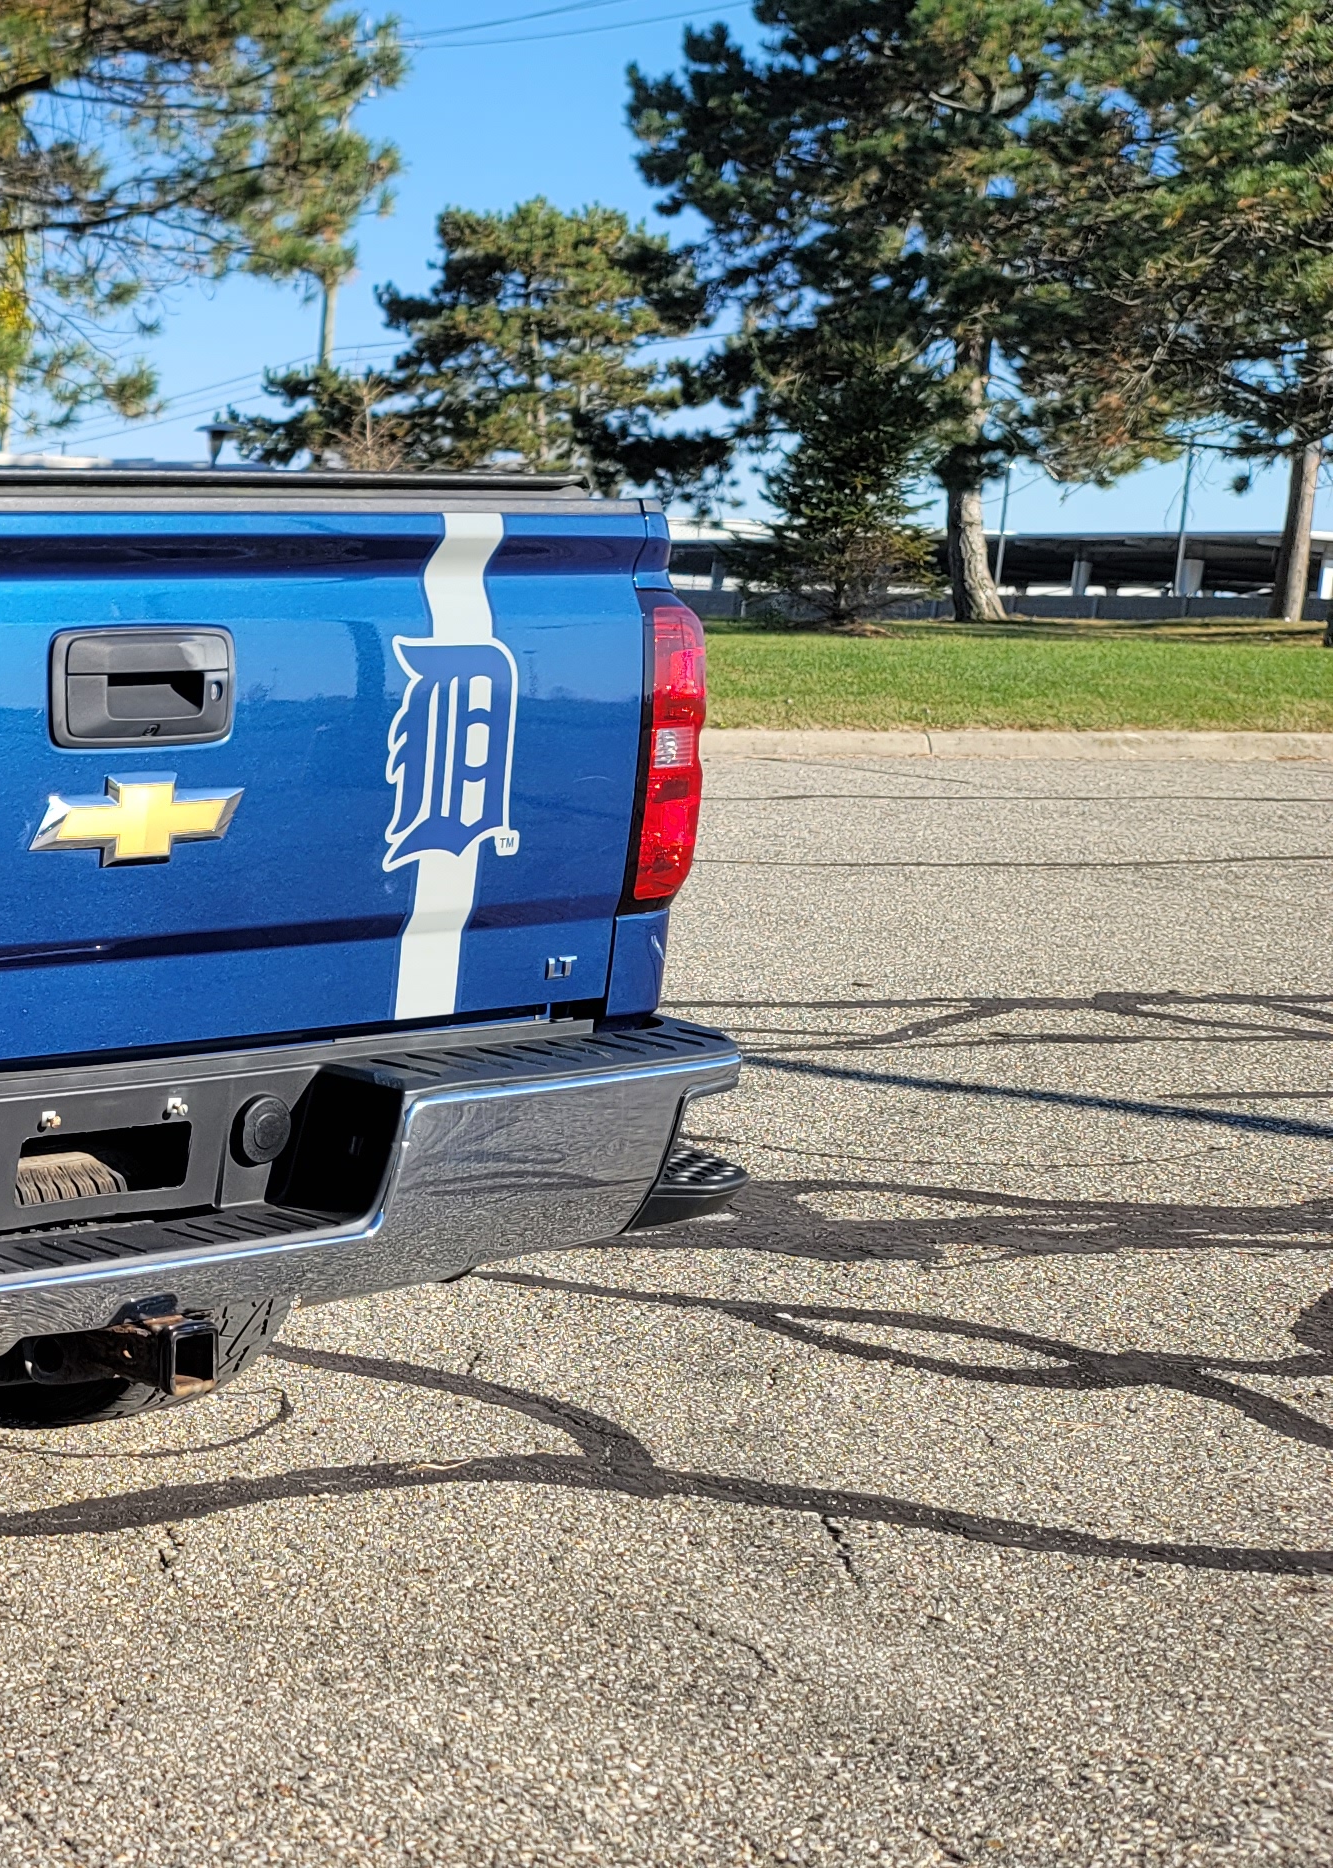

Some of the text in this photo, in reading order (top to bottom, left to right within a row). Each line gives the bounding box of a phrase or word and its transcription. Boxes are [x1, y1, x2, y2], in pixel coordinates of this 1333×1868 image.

[385, 638, 516, 868] D
[499, 836, 515, 849] TM
[545, 955, 578, 980] LT
